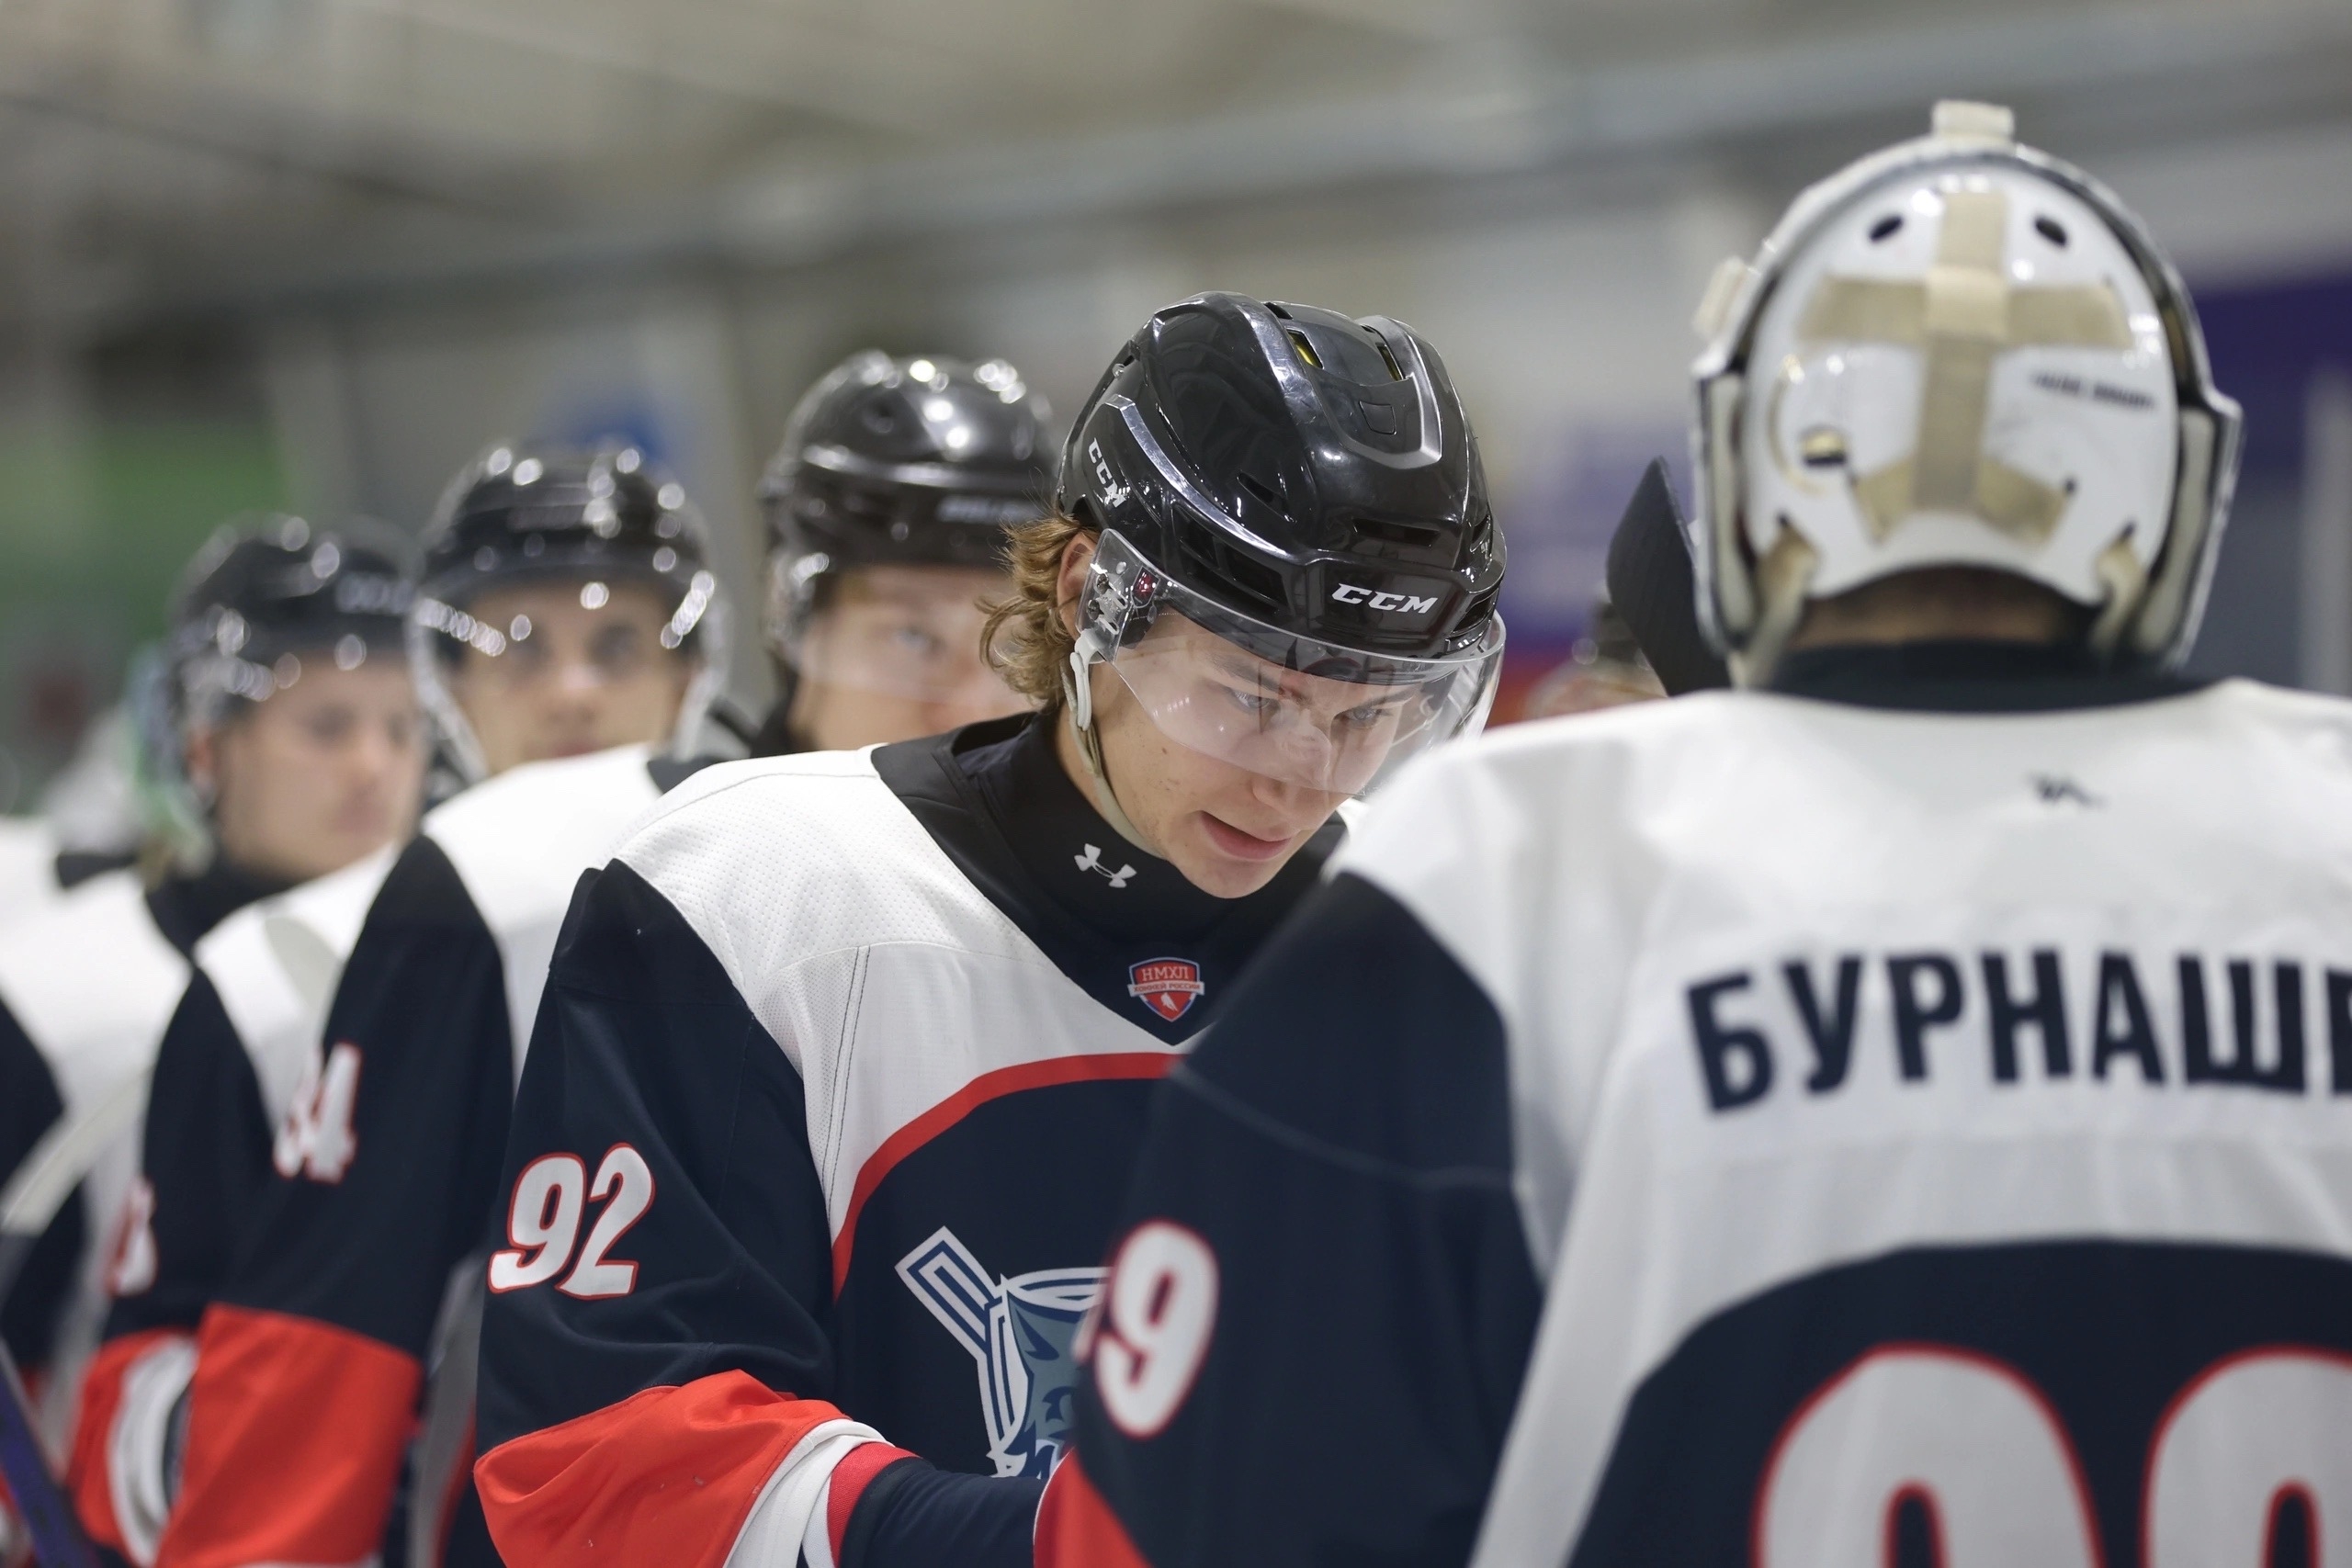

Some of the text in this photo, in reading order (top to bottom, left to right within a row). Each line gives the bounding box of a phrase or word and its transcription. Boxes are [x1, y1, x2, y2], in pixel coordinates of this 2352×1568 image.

[1088, 436, 1127, 509] CCM
[1331, 582, 1438, 614] CCM
[1141, 966, 1189, 981] НМХЛ
[488, 1142, 656, 1301] 92
